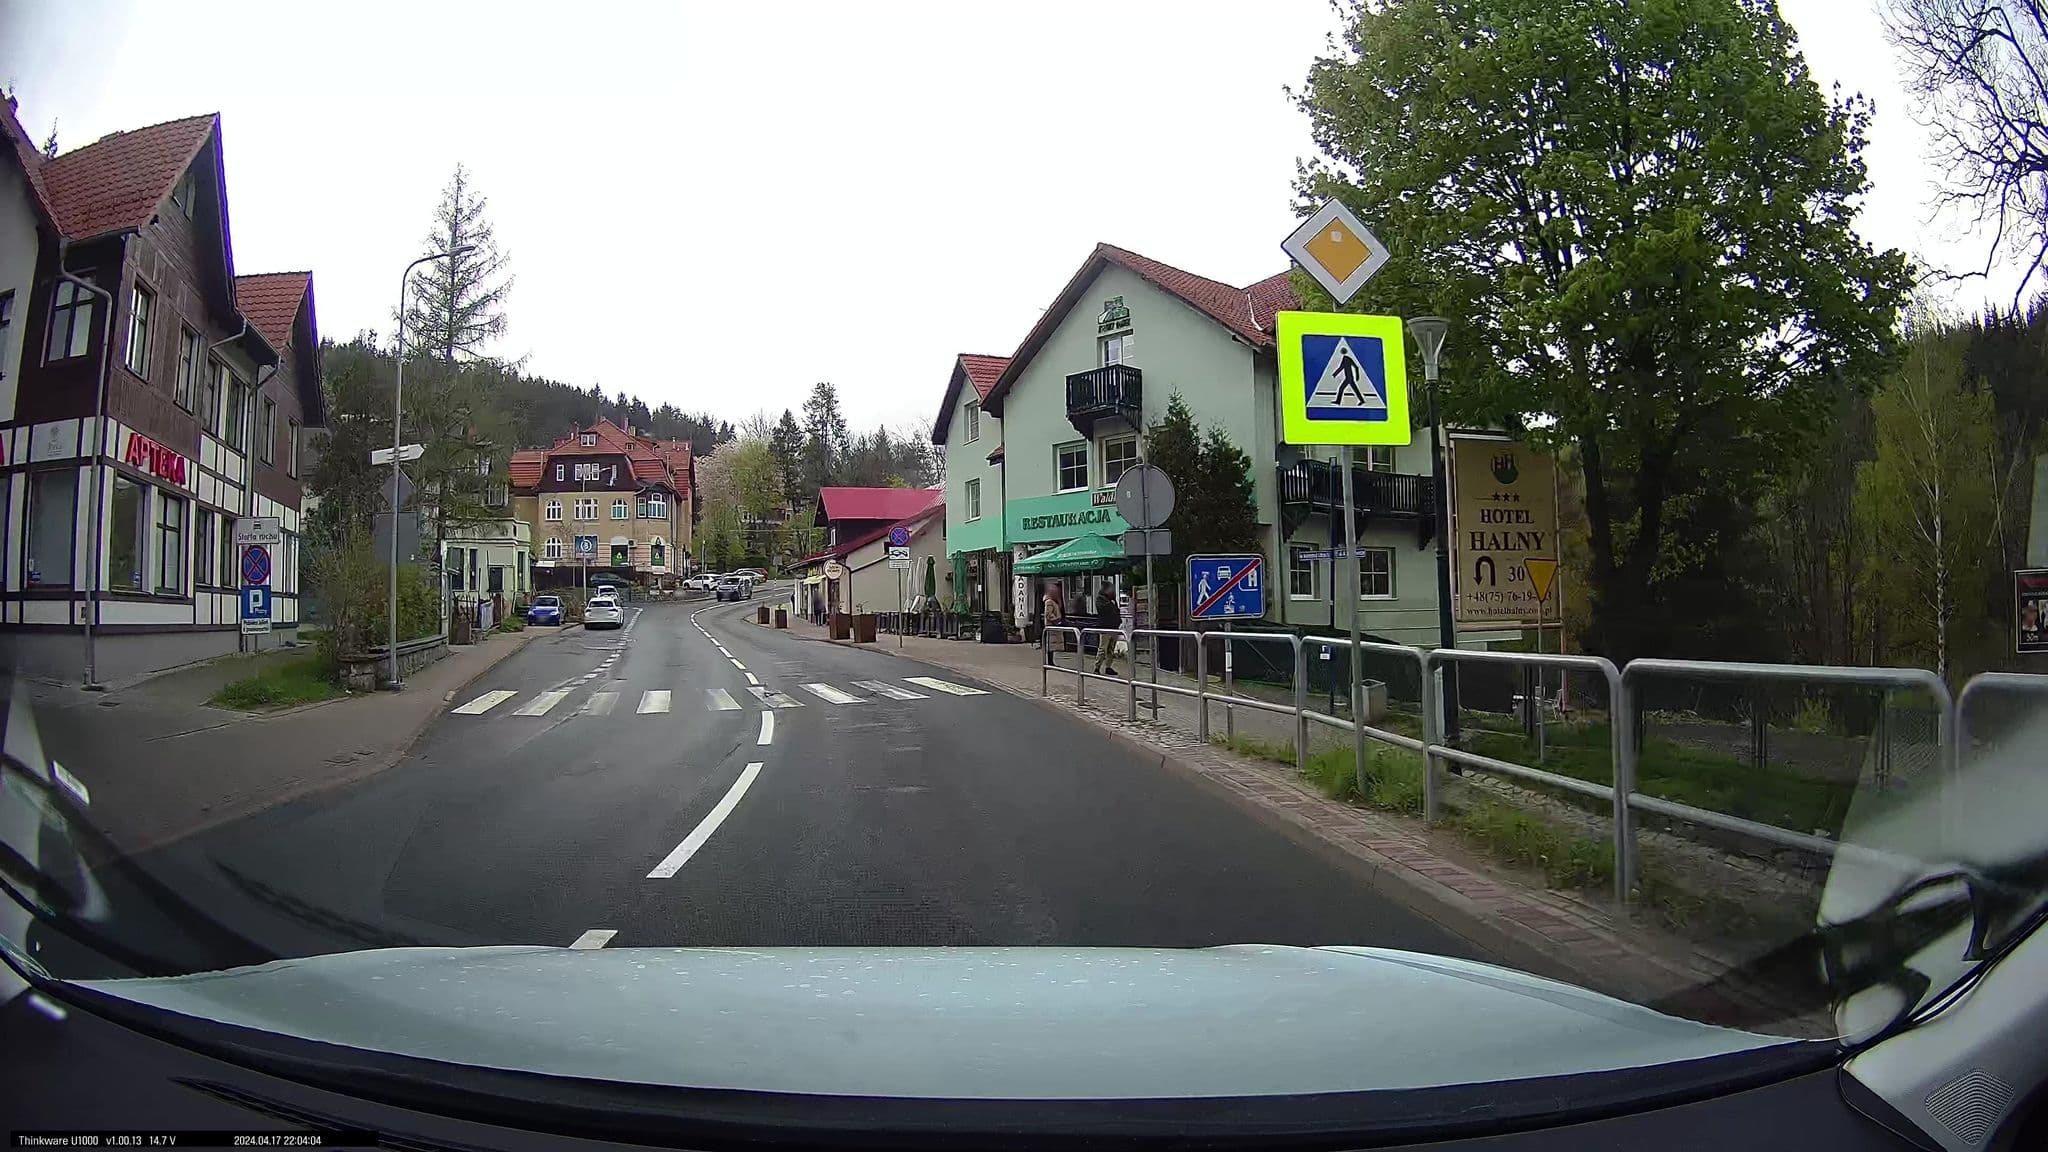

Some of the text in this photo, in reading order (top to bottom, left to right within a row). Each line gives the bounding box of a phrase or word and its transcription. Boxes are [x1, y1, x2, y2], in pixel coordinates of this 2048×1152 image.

[126, 432, 187, 486] APTEKA
[1022, 509, 1111, 530] RESTAURACJA
[1480, 509, 1535, 524] HOTEL
[1469, 531, 1546, 551] HALNY
